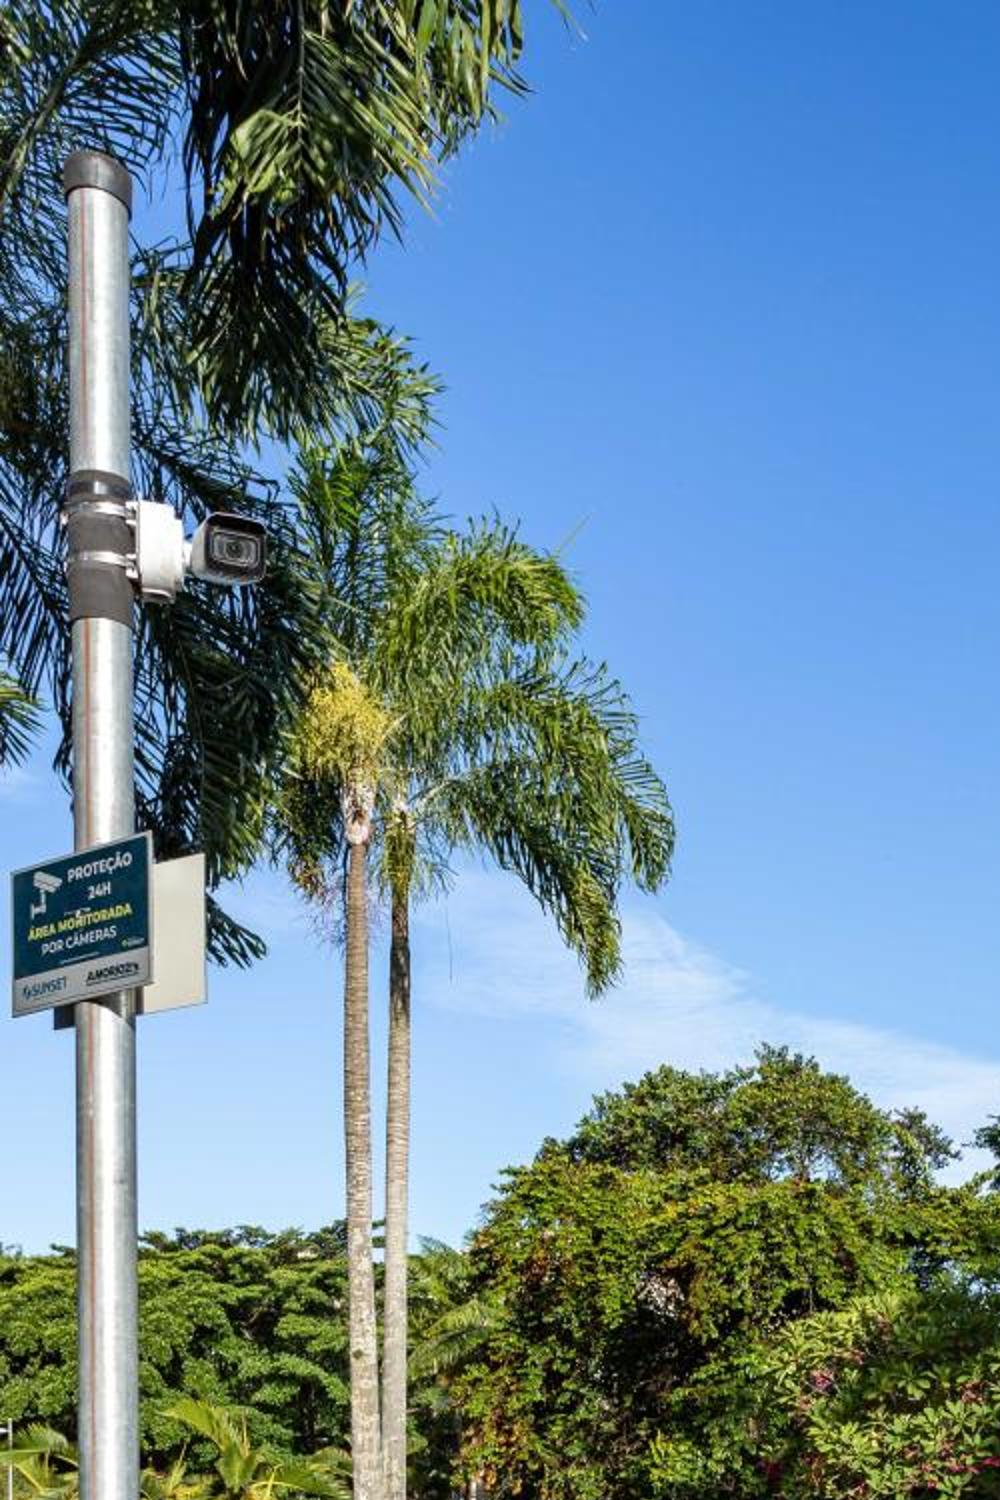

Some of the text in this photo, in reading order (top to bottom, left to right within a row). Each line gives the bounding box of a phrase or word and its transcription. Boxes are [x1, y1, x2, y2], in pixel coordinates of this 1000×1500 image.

[67, 851, 133, 882] PROTEÇÃO
[87, 882, 112, 900] 24H
[41, 941, 64, 956] POR
[66, 925, 117, 949] CÂMERAS
